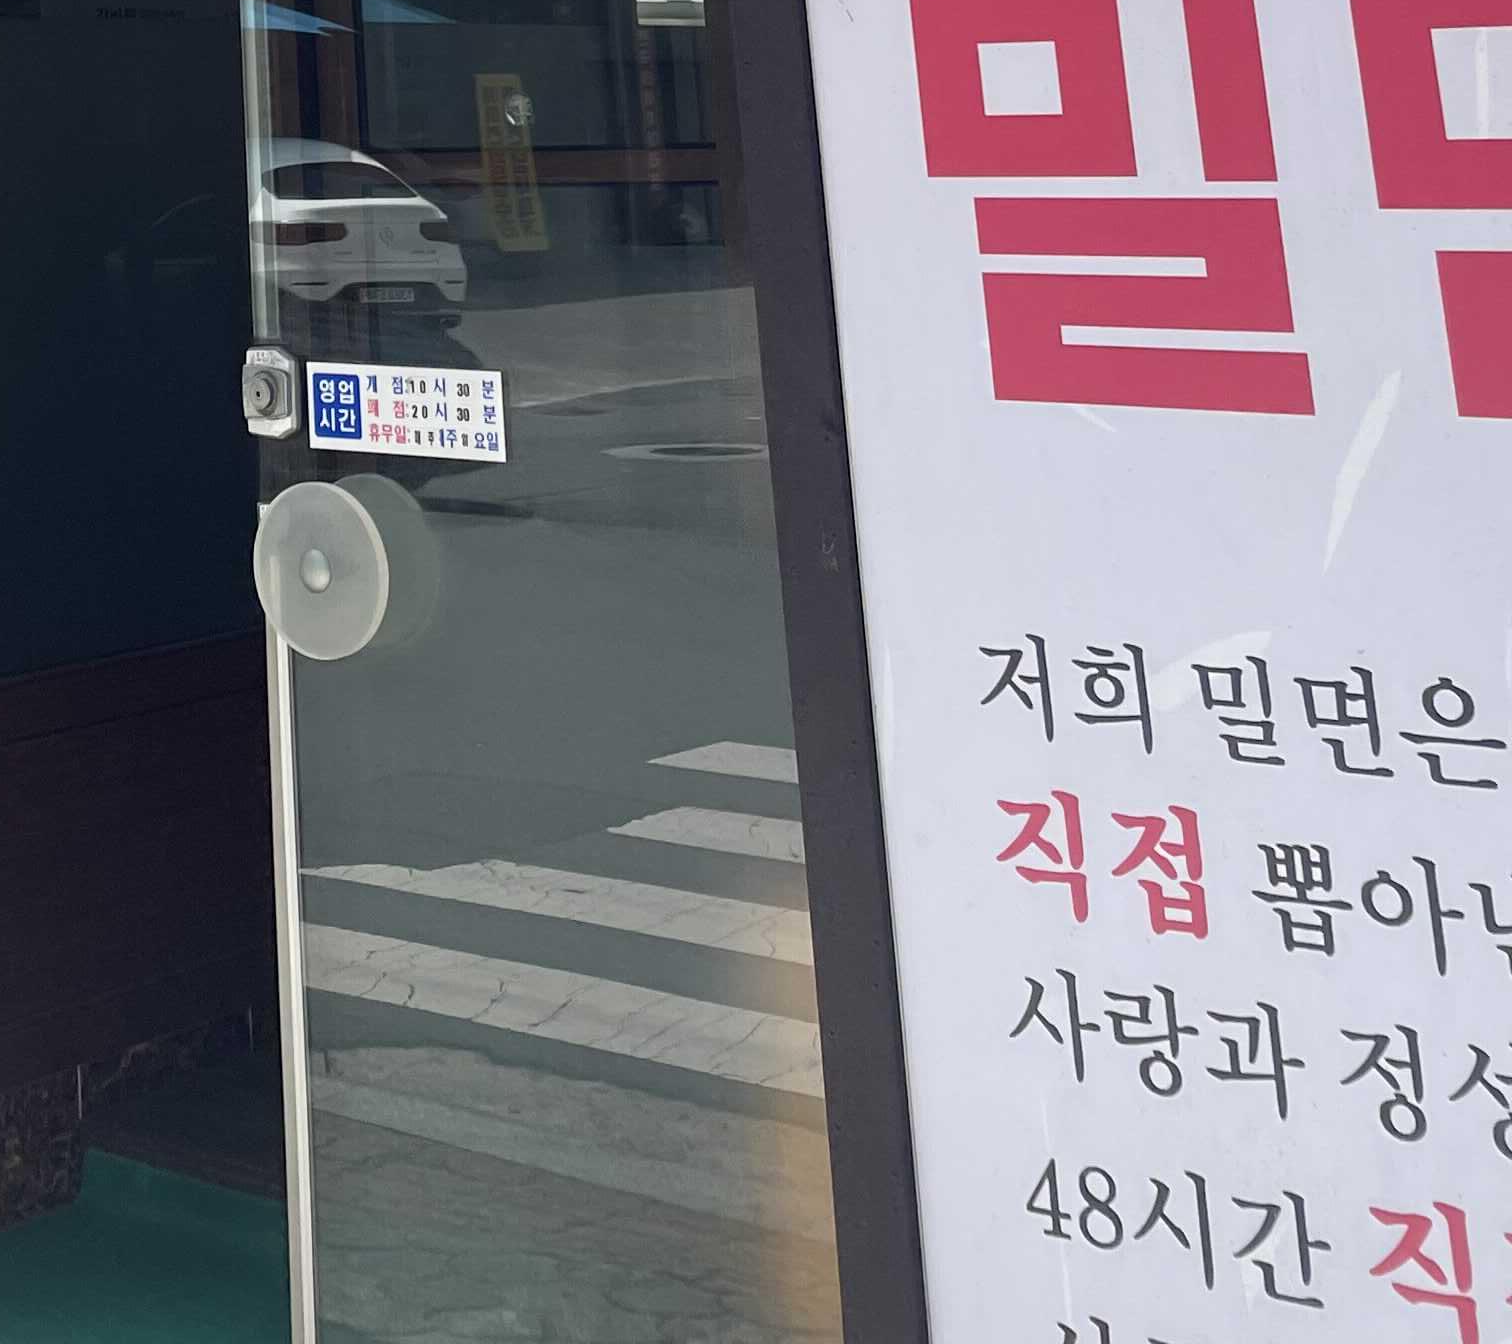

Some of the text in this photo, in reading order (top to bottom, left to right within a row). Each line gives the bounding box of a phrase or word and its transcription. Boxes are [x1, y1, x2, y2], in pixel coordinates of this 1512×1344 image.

[318, 379, 355, 404] 영업
[319, 409, 357, 433] 시간
[456, 383, 470, 397] 30
[456, 408, 470, 422] 30
[978, 633, 1507, 791] 저희 밀면은
[995, 789, 1209, 939] 직접
[1008, 967, 1305, 1121] 사랑과
[1026, 1157, 1512, 1344] 48시간 직
